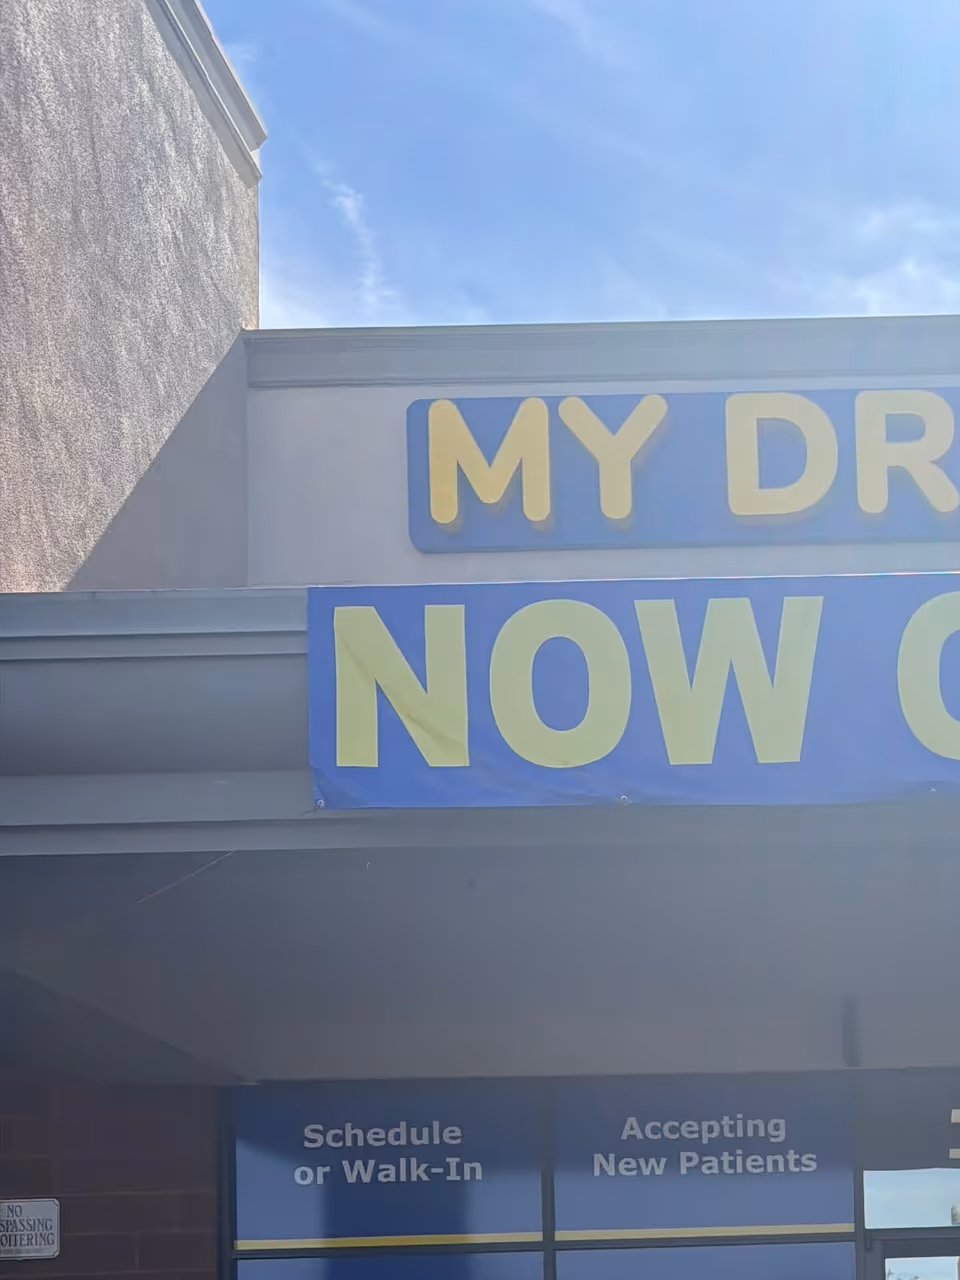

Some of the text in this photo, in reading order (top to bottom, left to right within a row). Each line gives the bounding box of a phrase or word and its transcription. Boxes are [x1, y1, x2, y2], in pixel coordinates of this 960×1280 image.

[428, 394, 668, 523] MY
[725, 389, 960, 516] DR
[334, 596, 824, 769] NOW
[303, 1120, 462, 1148] Schedule
[620, 1113, 787, 1144] Accepting
[293, 1156, 483, 1186] or Walk-In
[593, 1149, 818, 1177] New Patients
[6, 1204, 23, 1218] NO
